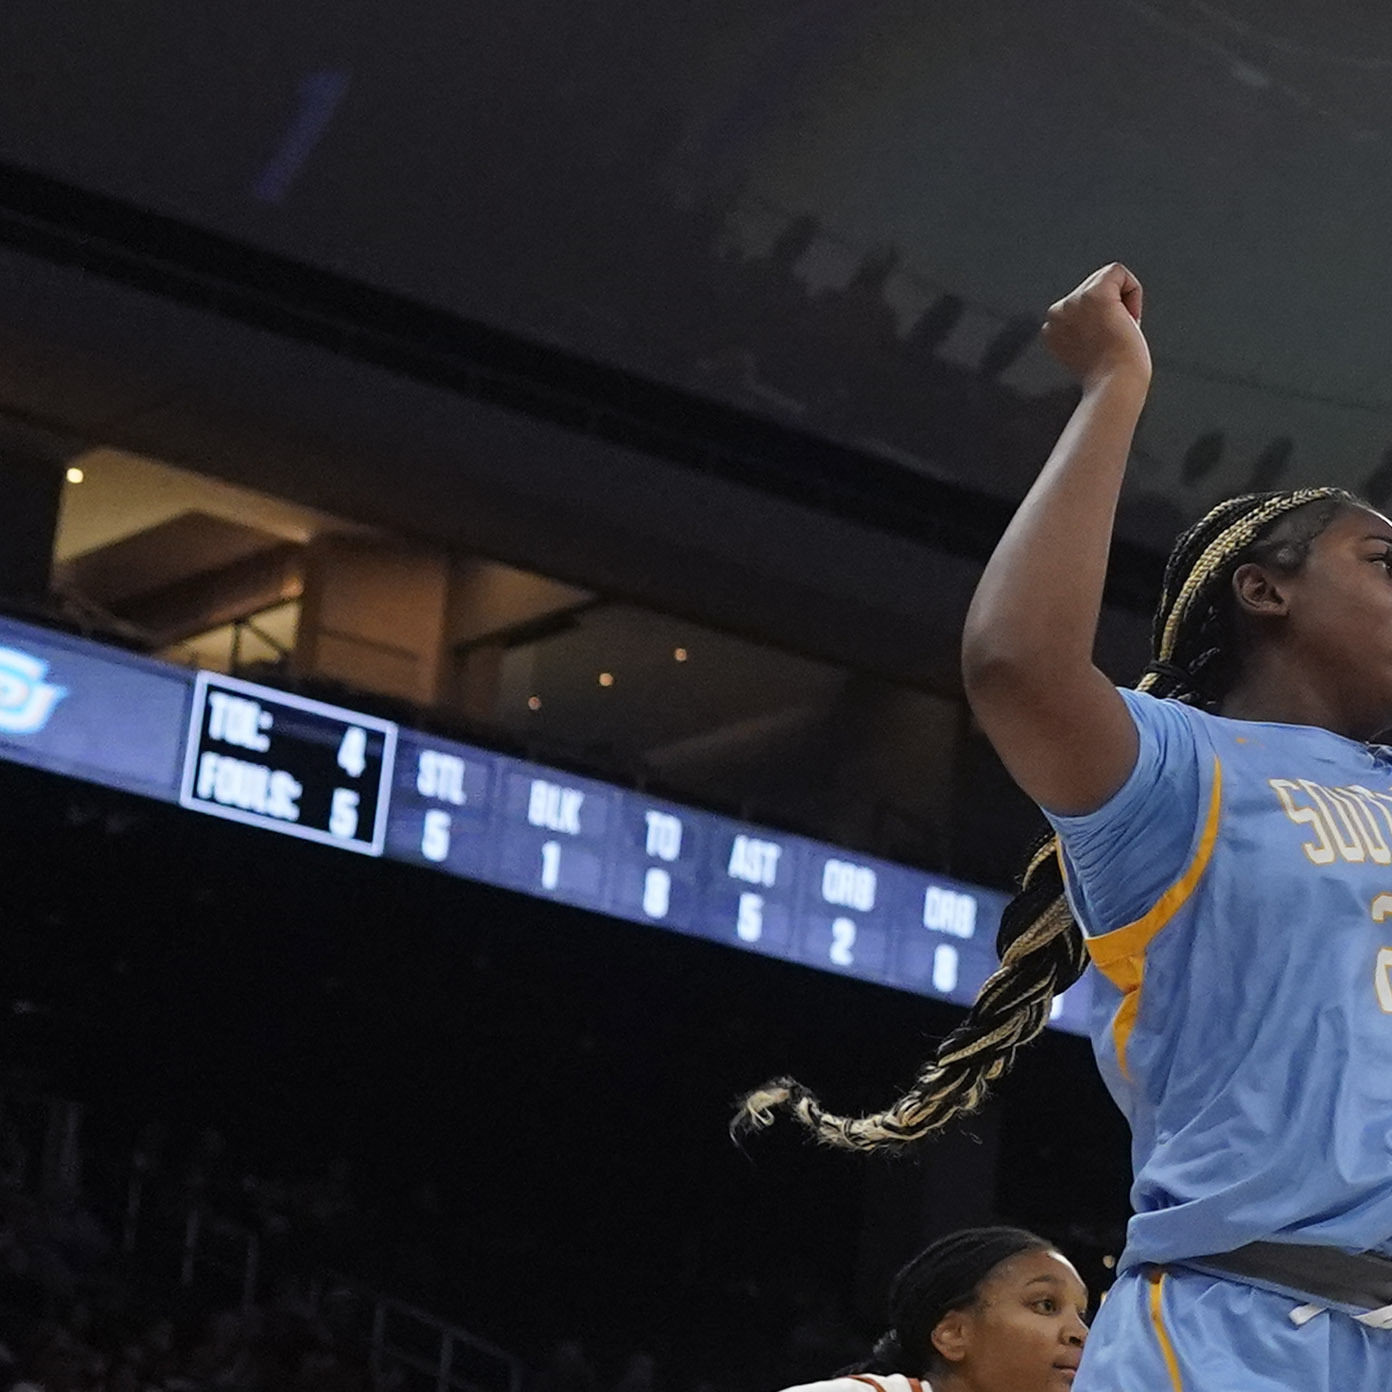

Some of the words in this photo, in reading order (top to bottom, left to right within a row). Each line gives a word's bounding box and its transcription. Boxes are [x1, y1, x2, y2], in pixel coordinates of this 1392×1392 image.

[337, 725, 367, 778] 4
[527, 779, 585, 836] BLK
[645, 810, 683, 862] TO
[728, 834, 782, 888] AST
[541, 839, 562, 890] 1
[829, 917, 857, 966] 2
